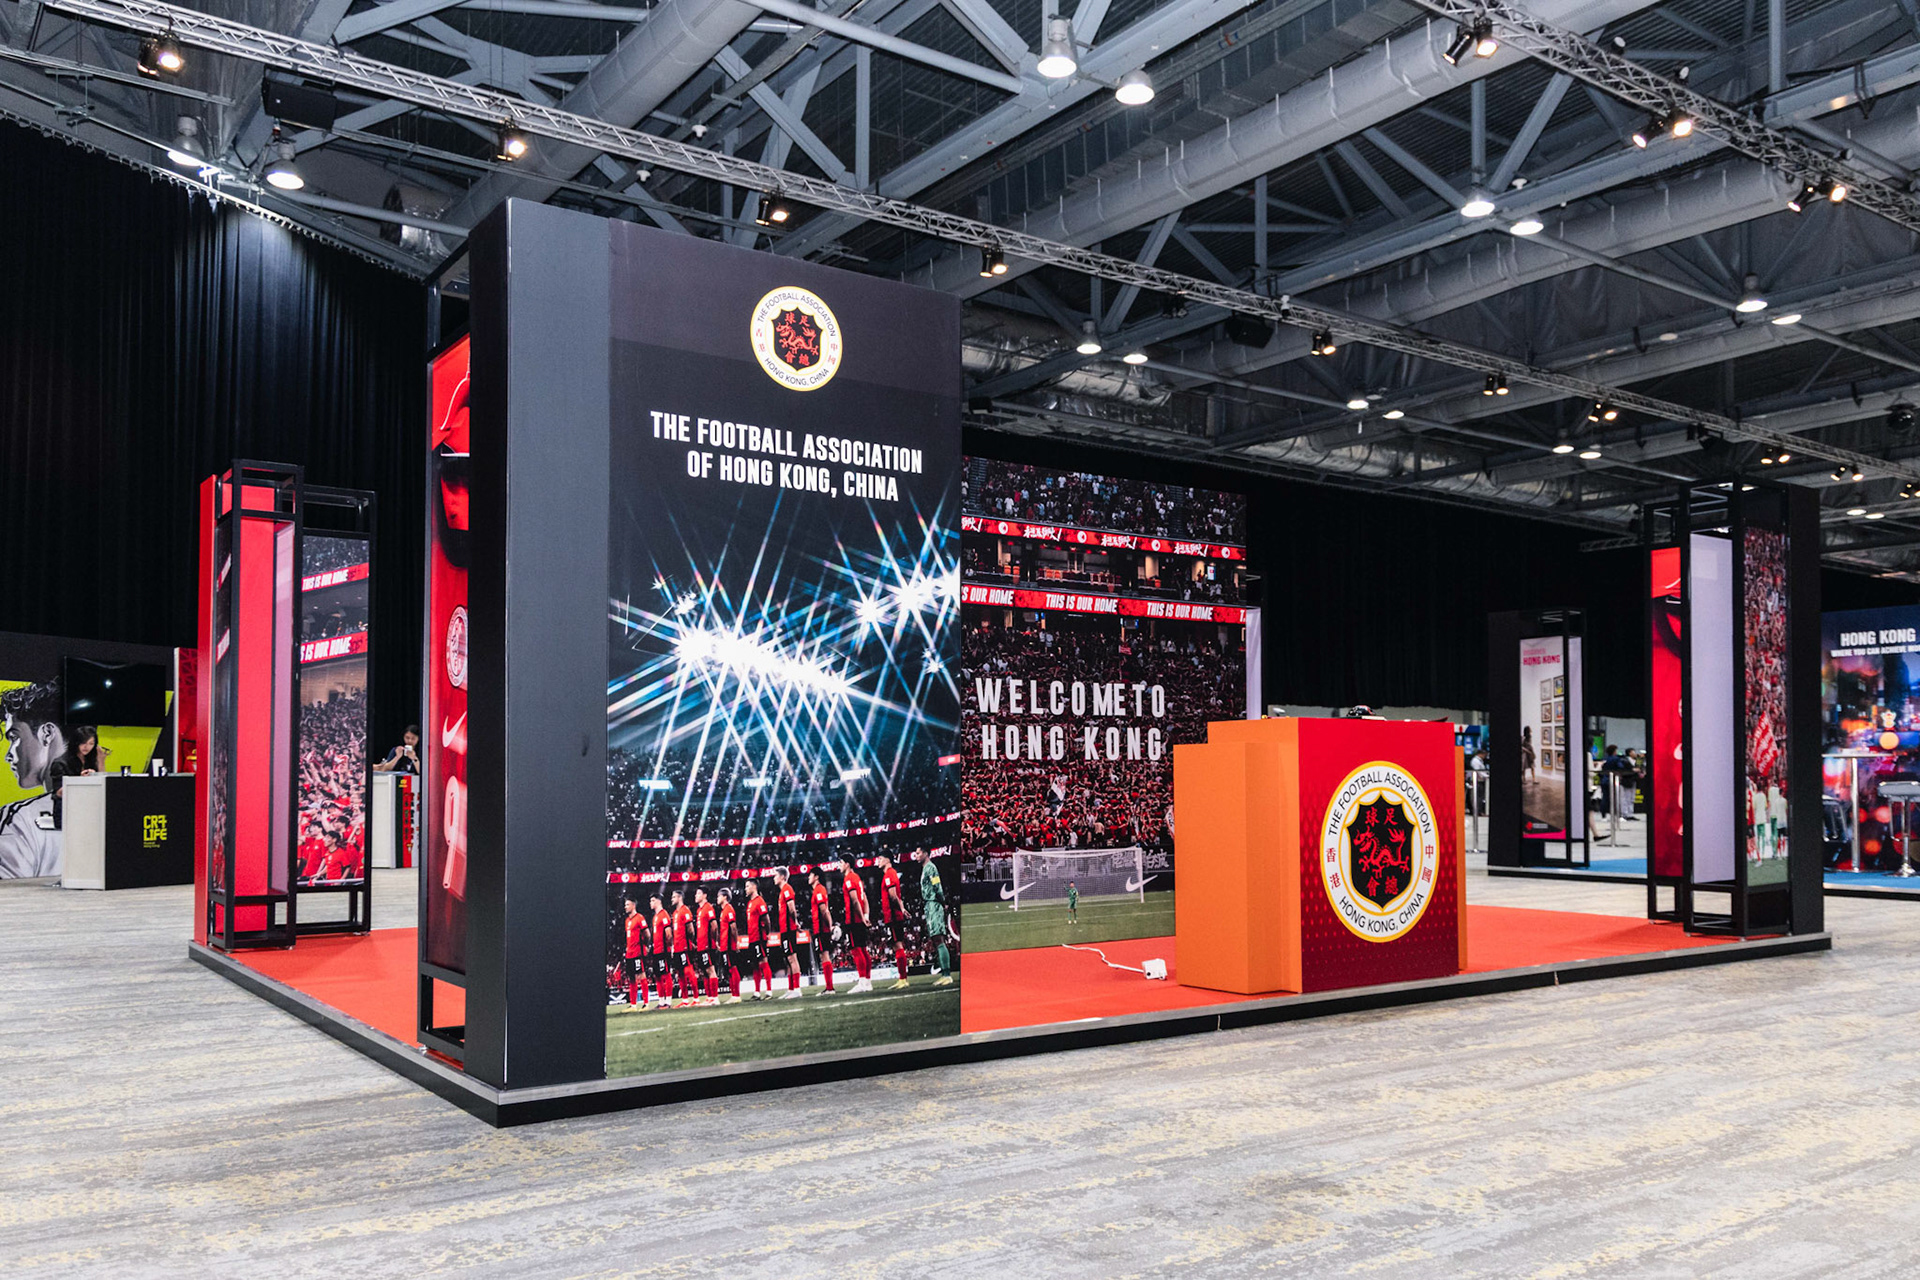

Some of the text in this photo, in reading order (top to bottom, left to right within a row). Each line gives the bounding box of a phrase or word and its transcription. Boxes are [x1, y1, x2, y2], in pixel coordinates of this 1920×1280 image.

[757, 292, 836, 337] THE FOOTBALL ASSOCIATION
[764, 357, 784, 379] HONG
[809, 368, 829, 384] CHINA
[650, 411, 923, 475] THE FOOTBALL ASSOCIATION
[687, 450, 899, 501] OF HONG KONG, CHINA
[970, 587, 987, 603] OUR
[988, 589, 1014, 605] HOME
[1045, 594, 1118, 613] THIS IS OUR HOME
[1147, 602, 1214, 620] THIS IS OUR HOME
[305, 643, 314, 660] IS
[314, 641, 329, 660] OUR
[329, 636, 352, 657] HOME
[1840, 628, 1916, 647] HONG KONG
[1830, 649, 1853, 658] WHERE
[1853, 648, 1866, 656] YOU
[1867, 647, 1880, 655] CAN
[1881, 645, 1907, 654] ACHIEVE
[975, 677, 1165, 718] WELCOME TO
[981, 724, 1162, 761] HONG KONG
[1328, 771, 1431, 836] THE FOOTBALL ASSOCIATION
[143, 815, 168, 829] CR7
[143, 828, 168, 842] LIFE
[1339, 892, 1425, 933] HONG KONG, CHINA
